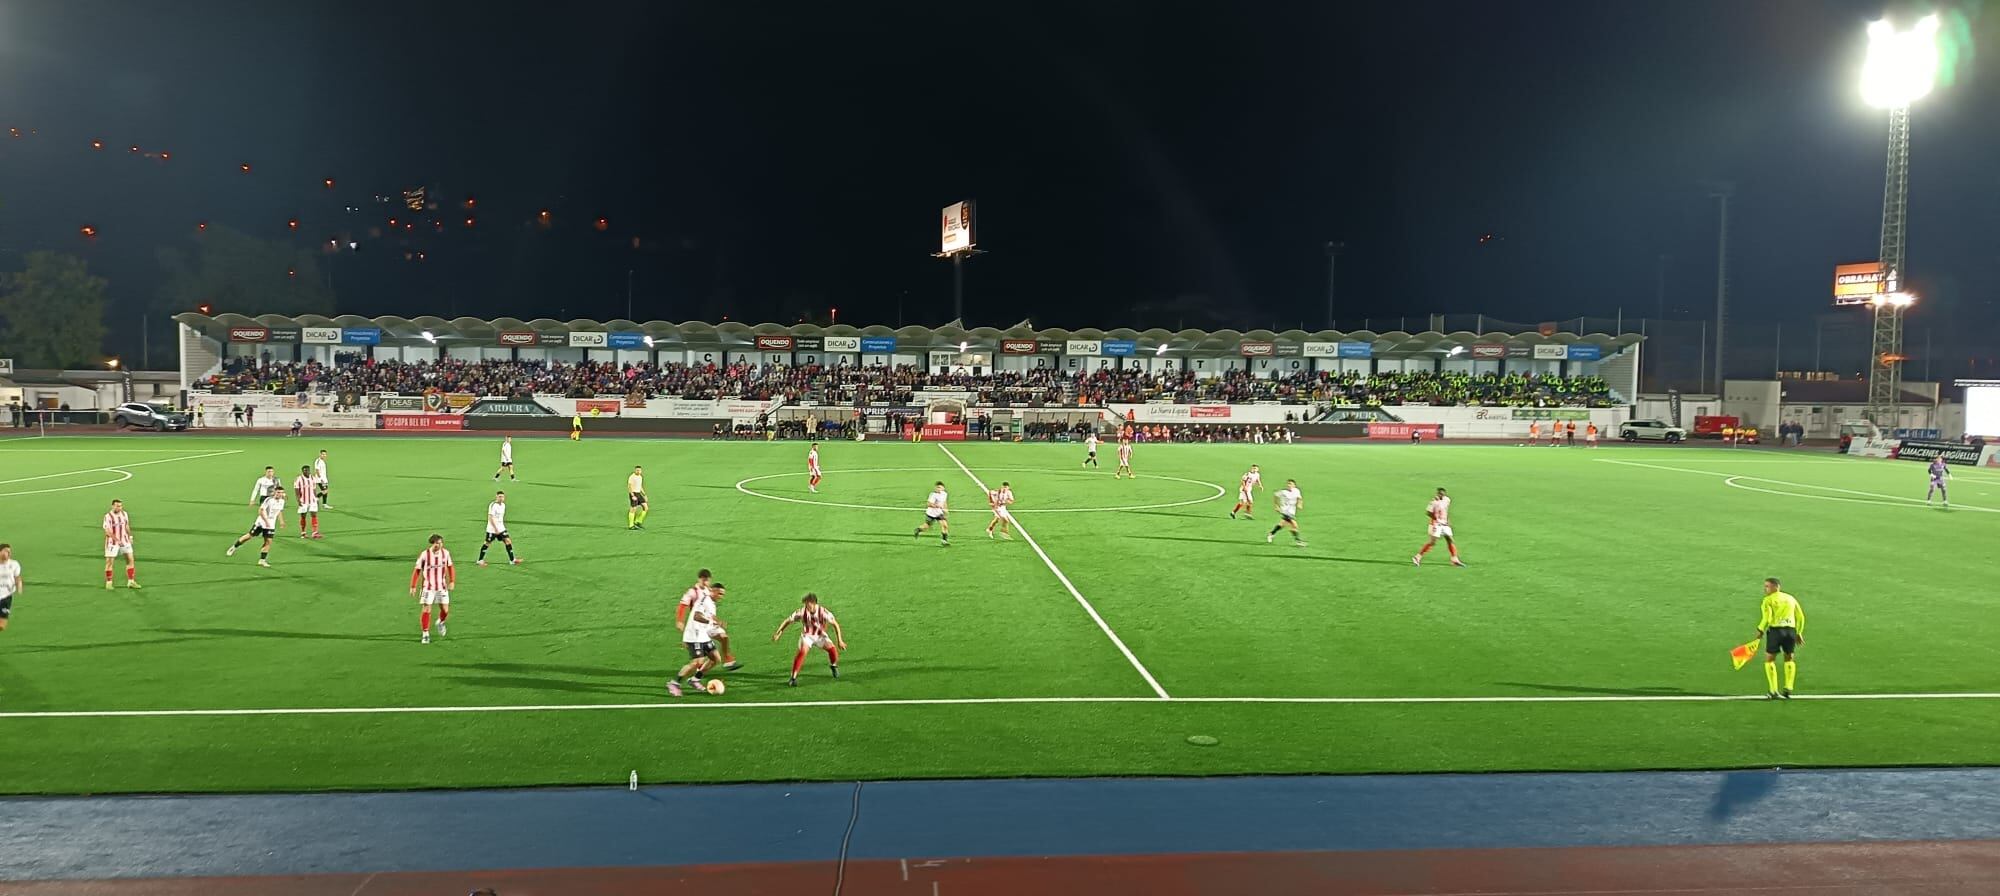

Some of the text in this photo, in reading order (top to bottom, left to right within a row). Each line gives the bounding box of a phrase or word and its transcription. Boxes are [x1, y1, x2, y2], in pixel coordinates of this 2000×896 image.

[232, 330, 265, 339] OQUENDO
[502, 334, 533, 343] OQUENDO
[760, 339, 790, 348] OQUENDO
[1005, 343, 1034, 352] OQUENDO
[390, 399, 413, 407] IDEAS
[487, 403, 530, 413] ARDURA
[393, 417, 430, 427] COPA DEL REY
[1898, 446, 1940, 458] ALMACENES
[1940, 448, 1980, 461] ARGÜELLES
